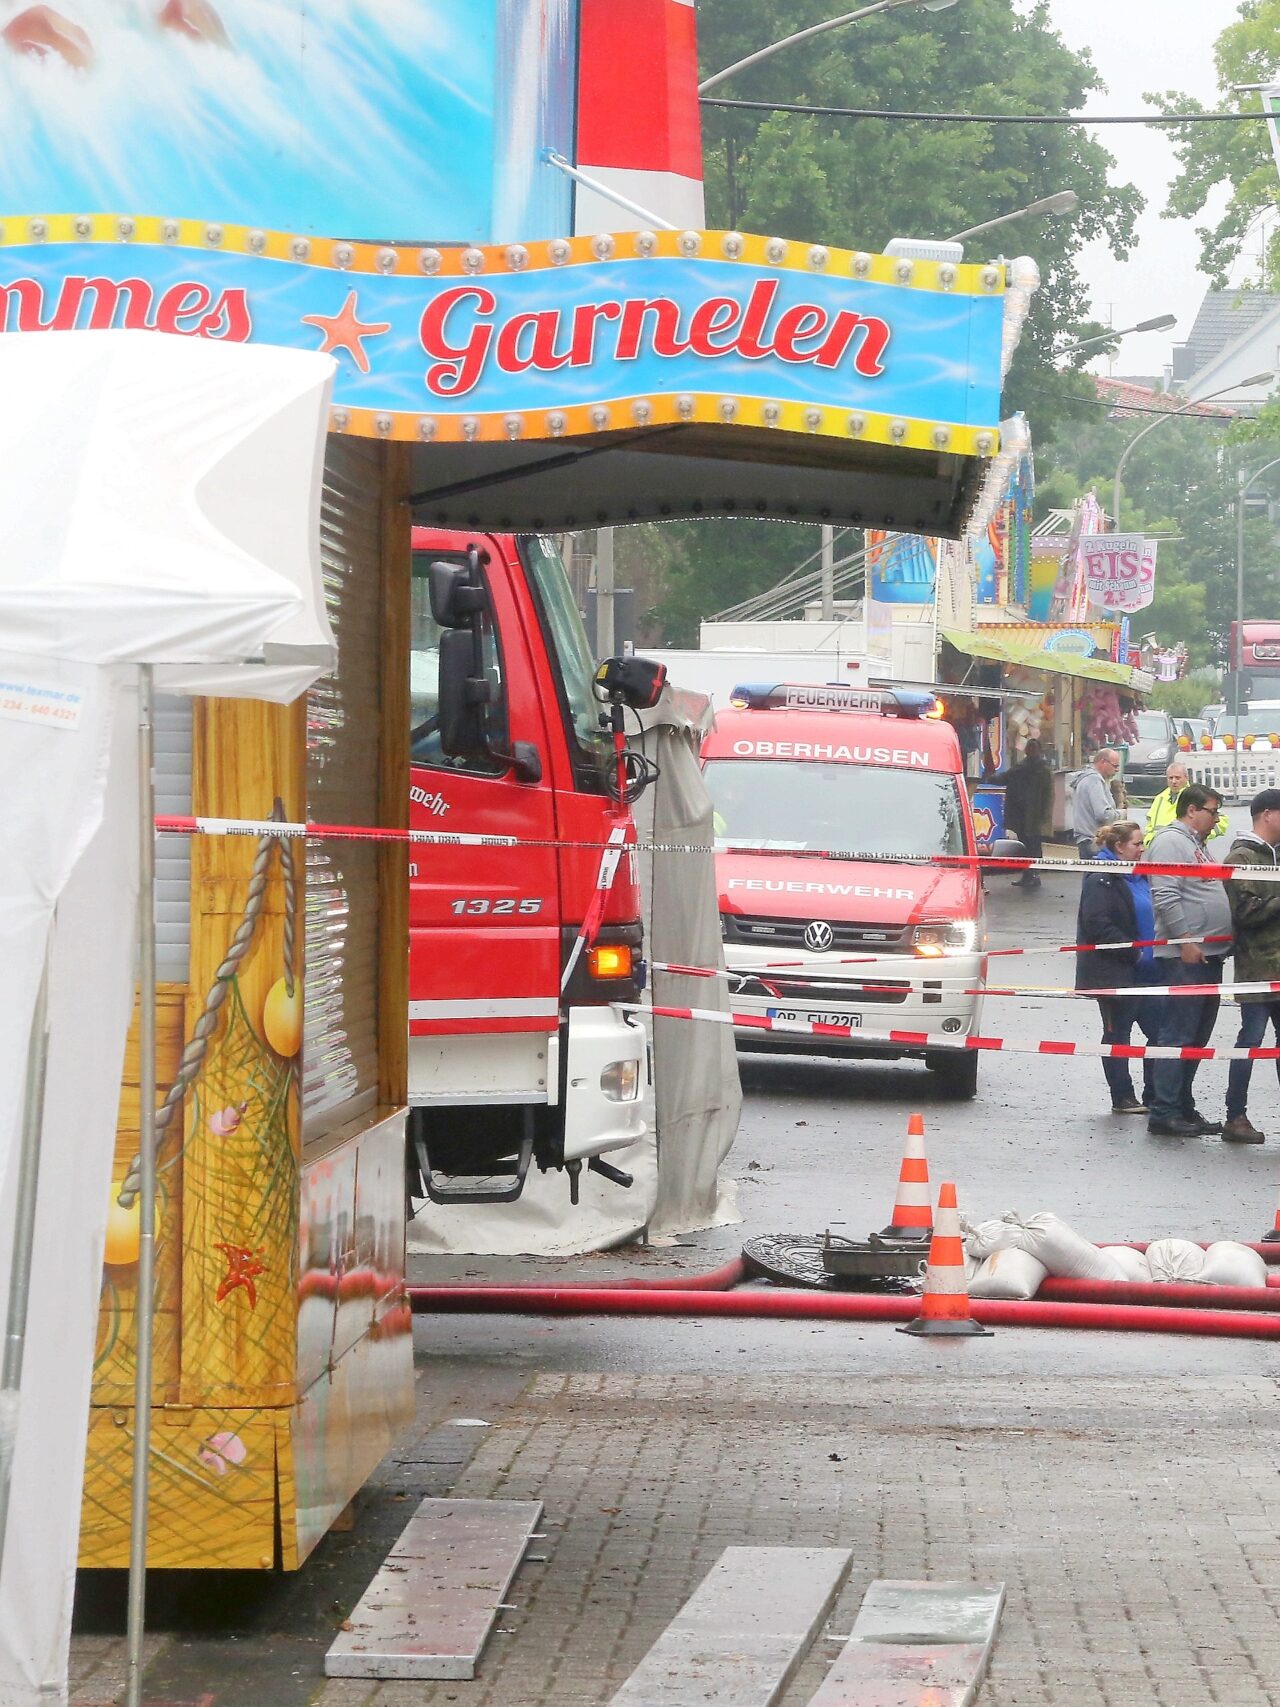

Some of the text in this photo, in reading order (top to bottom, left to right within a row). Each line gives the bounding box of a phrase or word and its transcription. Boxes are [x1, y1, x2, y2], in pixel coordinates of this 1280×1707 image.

[419, 279, 891, 398] Garnelen
[1085, 552, 1139, 580] EIS
[787, 688, 880, 710] FEUERWEHR
[733, 740, 930, 767] OBERHAUSEN
[728, 878, 915, 900] FEUERWEHR
[450, 899, 543, 915] 1325
